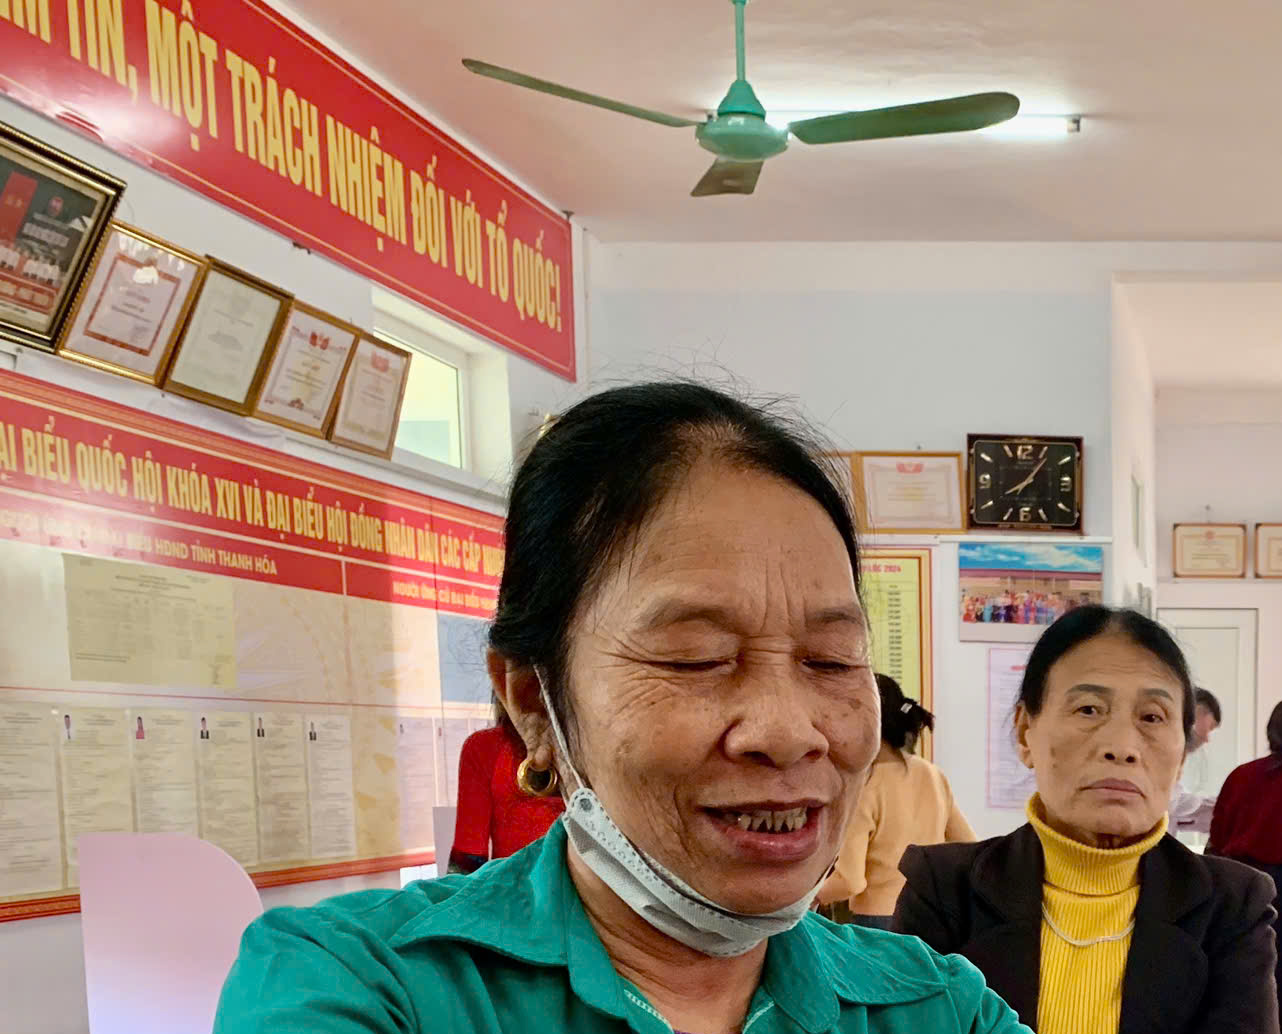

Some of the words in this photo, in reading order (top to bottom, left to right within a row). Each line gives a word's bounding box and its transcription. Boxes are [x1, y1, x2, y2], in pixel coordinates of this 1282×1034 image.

[145, 0, 219, 152] MỘT
[226, 48, 322, 197] TRÁCH
[326, 114, 407, 253] NHIỆM
[410, 156, 446, 256] ĐỐI
[450, 190, 484, 288] VỚI
[486, 200, 510, 302] TỔ
[512, 229, 562, 333] QUỐC!
[1017, 445, 1033, 460] 12
[21, 415, 71, 484] BIỂU
[75, 434, 128, 498] QUỐC
[131, 450, 163, 512] HỘI
[166, 463, 213, 516] KHÓA
[214, 477, 241, 521] XVI
[243, 479, 264, 527] VÀ
[266, 490, 291, 539] ĐẠI
[293, 486, 324, 540] BIỂU
[979, 474, 991, 489] 9
[1060, 474, 1072, 491] 3
[1020, 507, 1031, 521] 6
